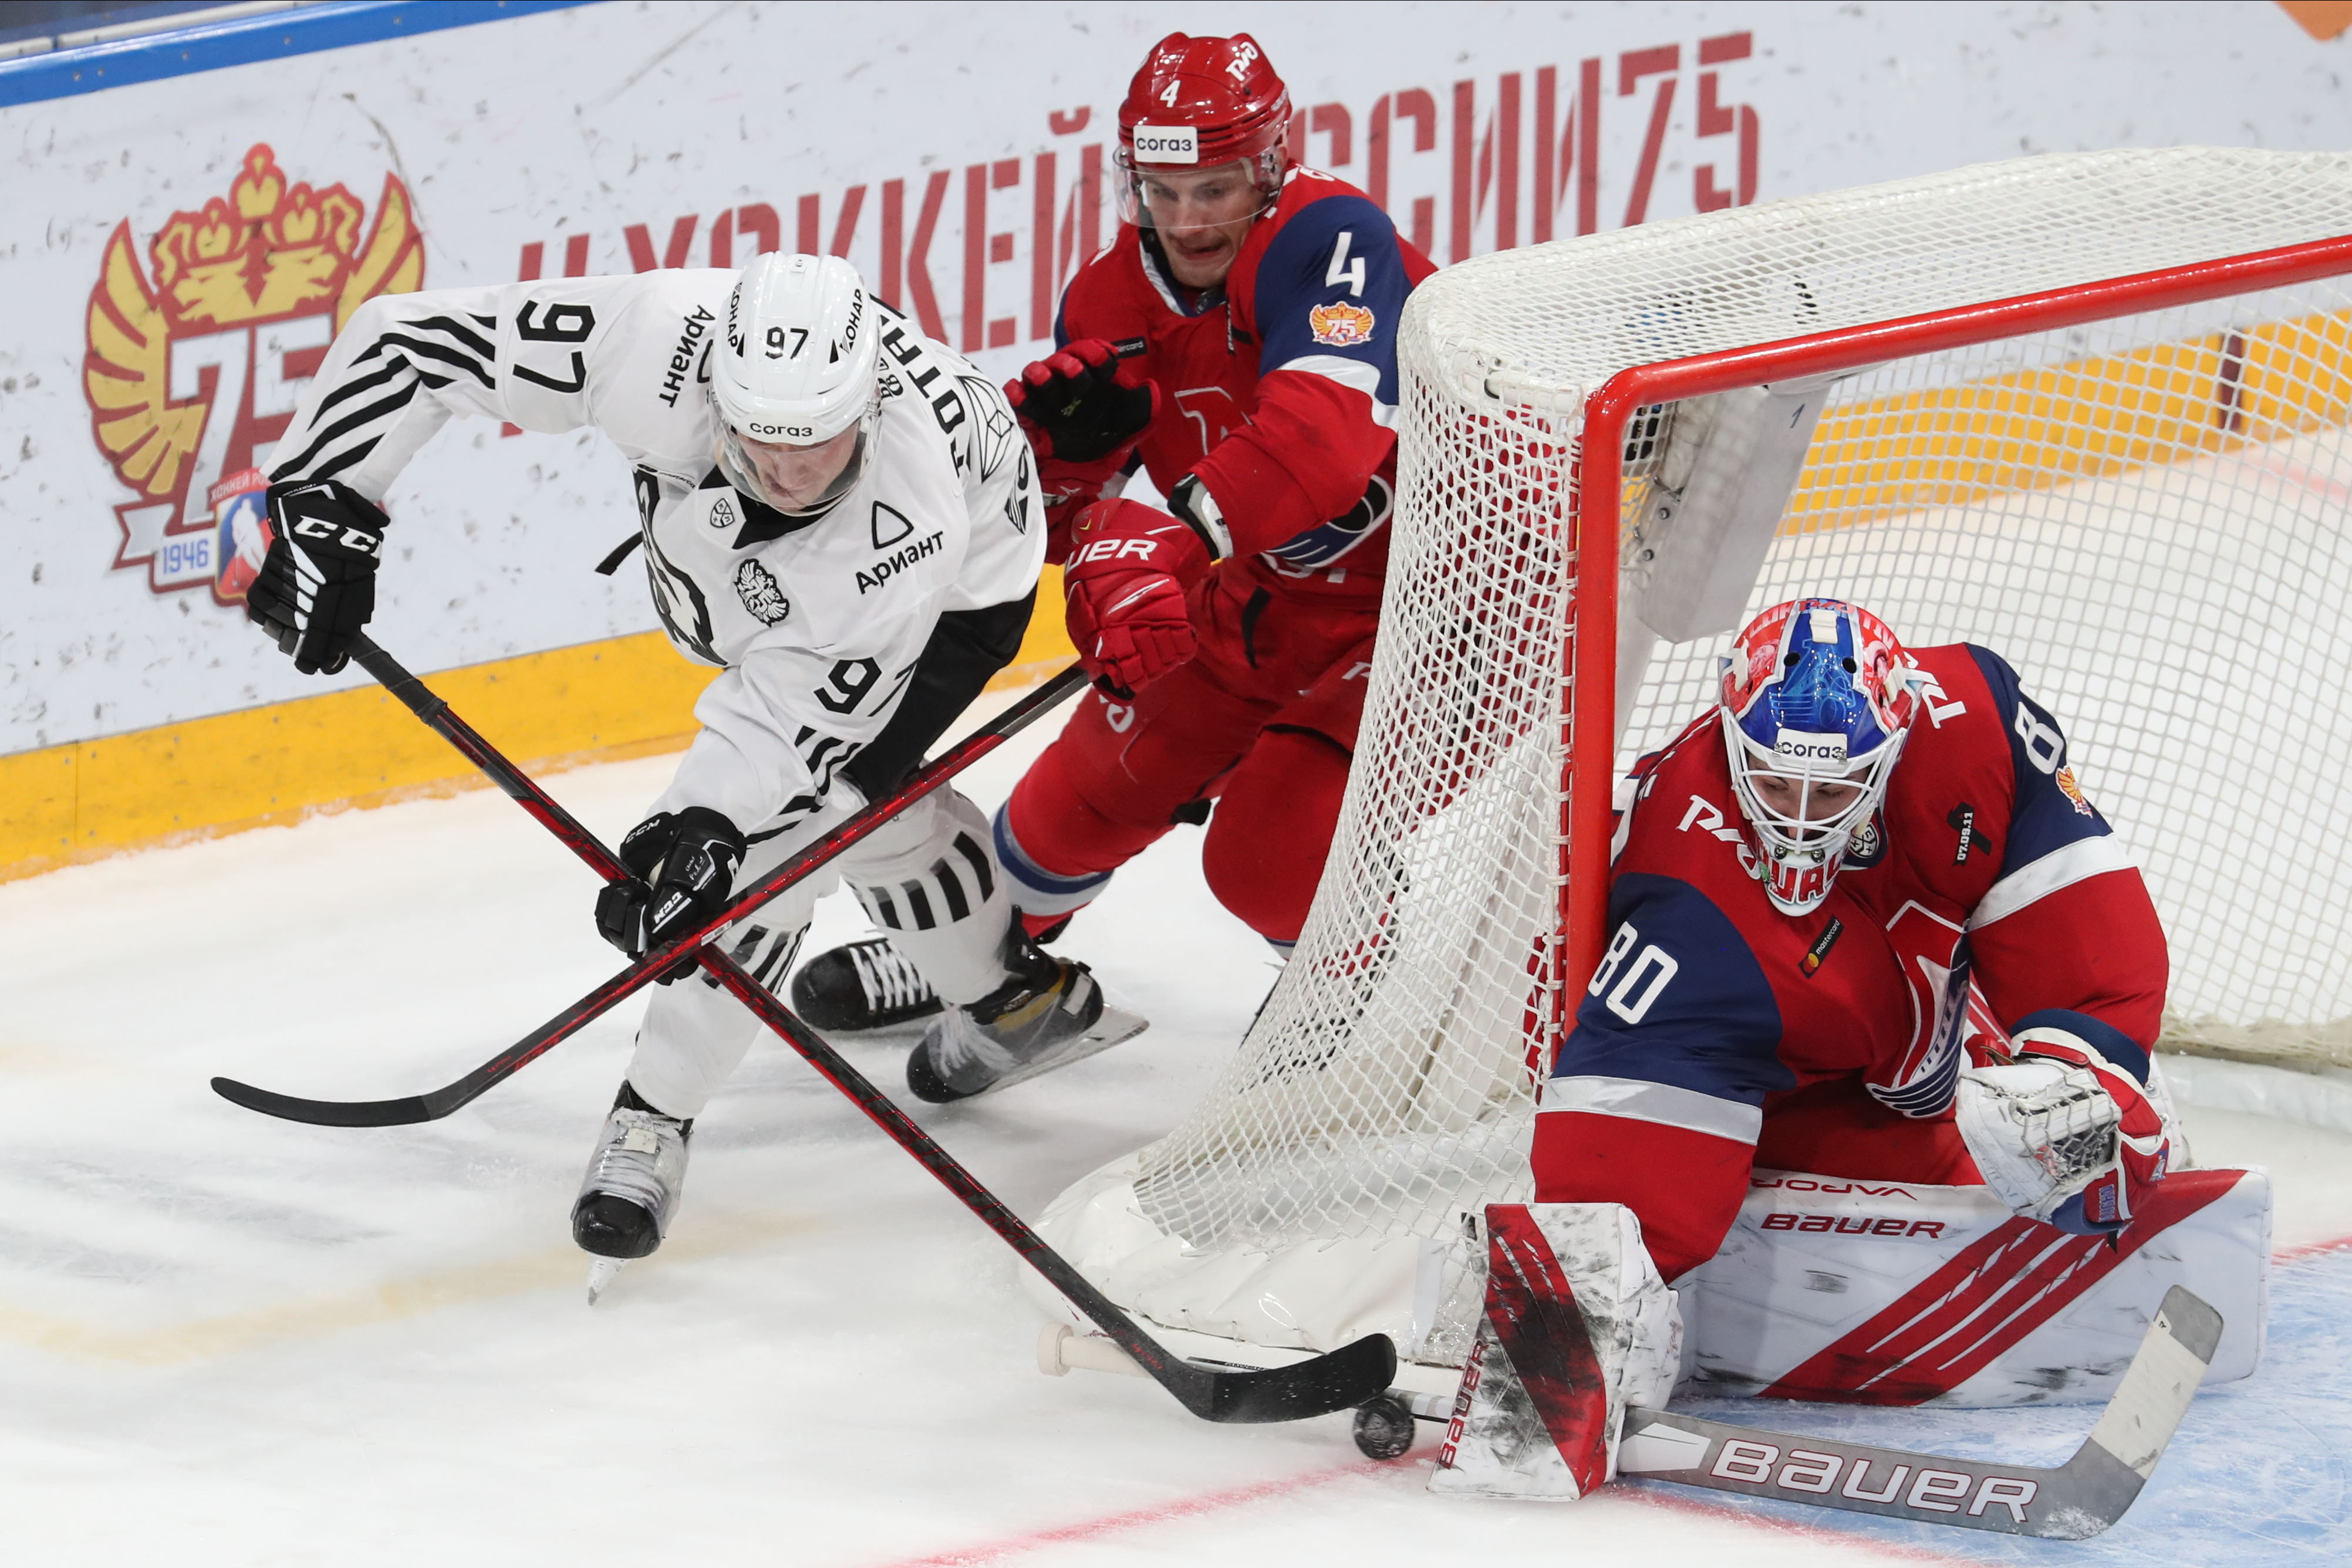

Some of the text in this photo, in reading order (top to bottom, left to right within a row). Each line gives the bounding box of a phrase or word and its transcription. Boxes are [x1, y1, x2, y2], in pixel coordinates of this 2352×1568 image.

[1159, 79, 1181, 108] 4
[1325, 231, 1366, 298] 4
[512, 299, 596, 394] 97
[765, 326, 809, 360] 97
[1326, 319, 1356, 337] 75
[659, 304, 716, 408] Ариант
[161, 538, 209, 575] 1946
[855, 530, 944, 595] Ариант
[625, 819, 660, 844] CCM
[1957, 812, 1973, 861] 07.09.11
[1815, 918, 1841, 955] mastercard
[1588, 921, 1679, 1025] 80
[1709, 1438, 2039, 1522] BAUER
